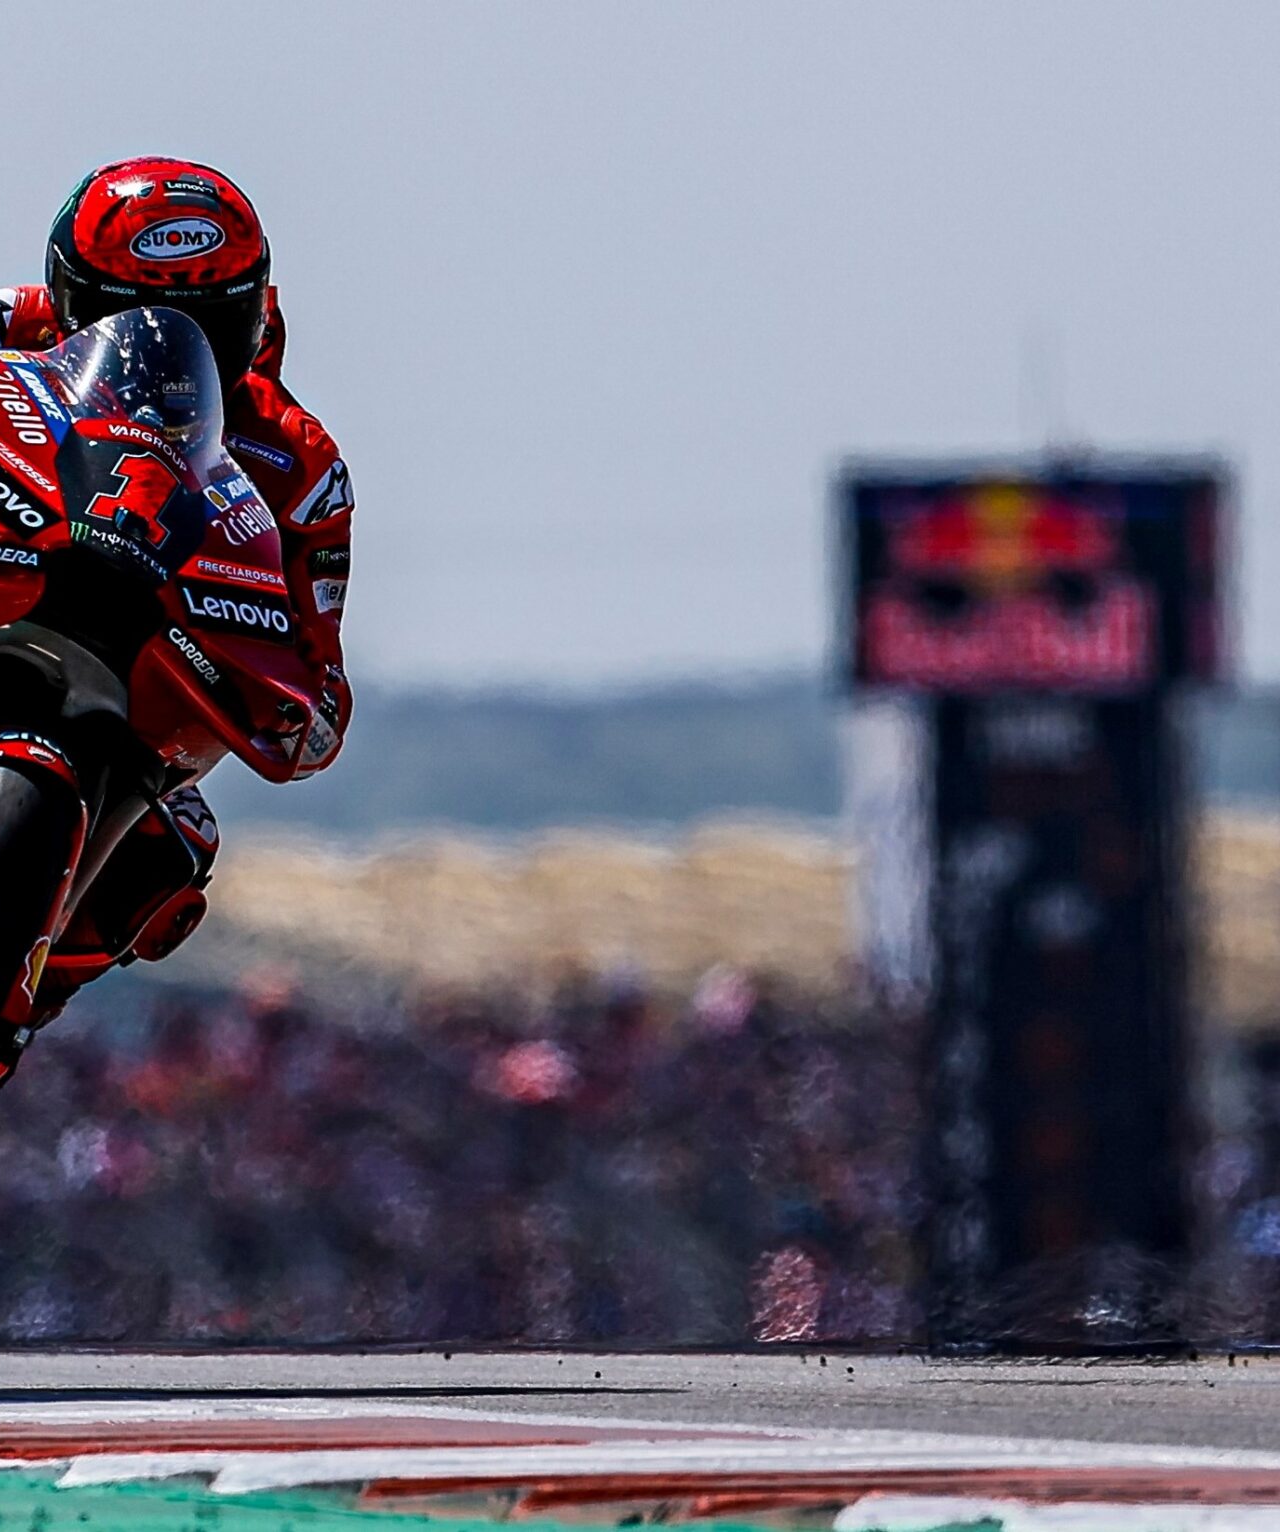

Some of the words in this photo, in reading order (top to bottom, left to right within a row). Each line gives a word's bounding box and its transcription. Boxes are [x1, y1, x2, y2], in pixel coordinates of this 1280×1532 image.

[140, 229, 217, 247] SUOMY
[238, 442, 286, 465] MICHELIN
[85, 451, 182, 550] 1
[197, 559, 286, 586] FRECCIAROSSA
[183, 587, 288, 633] Lenovo
[169, 627, 220, 685] CARRERA
